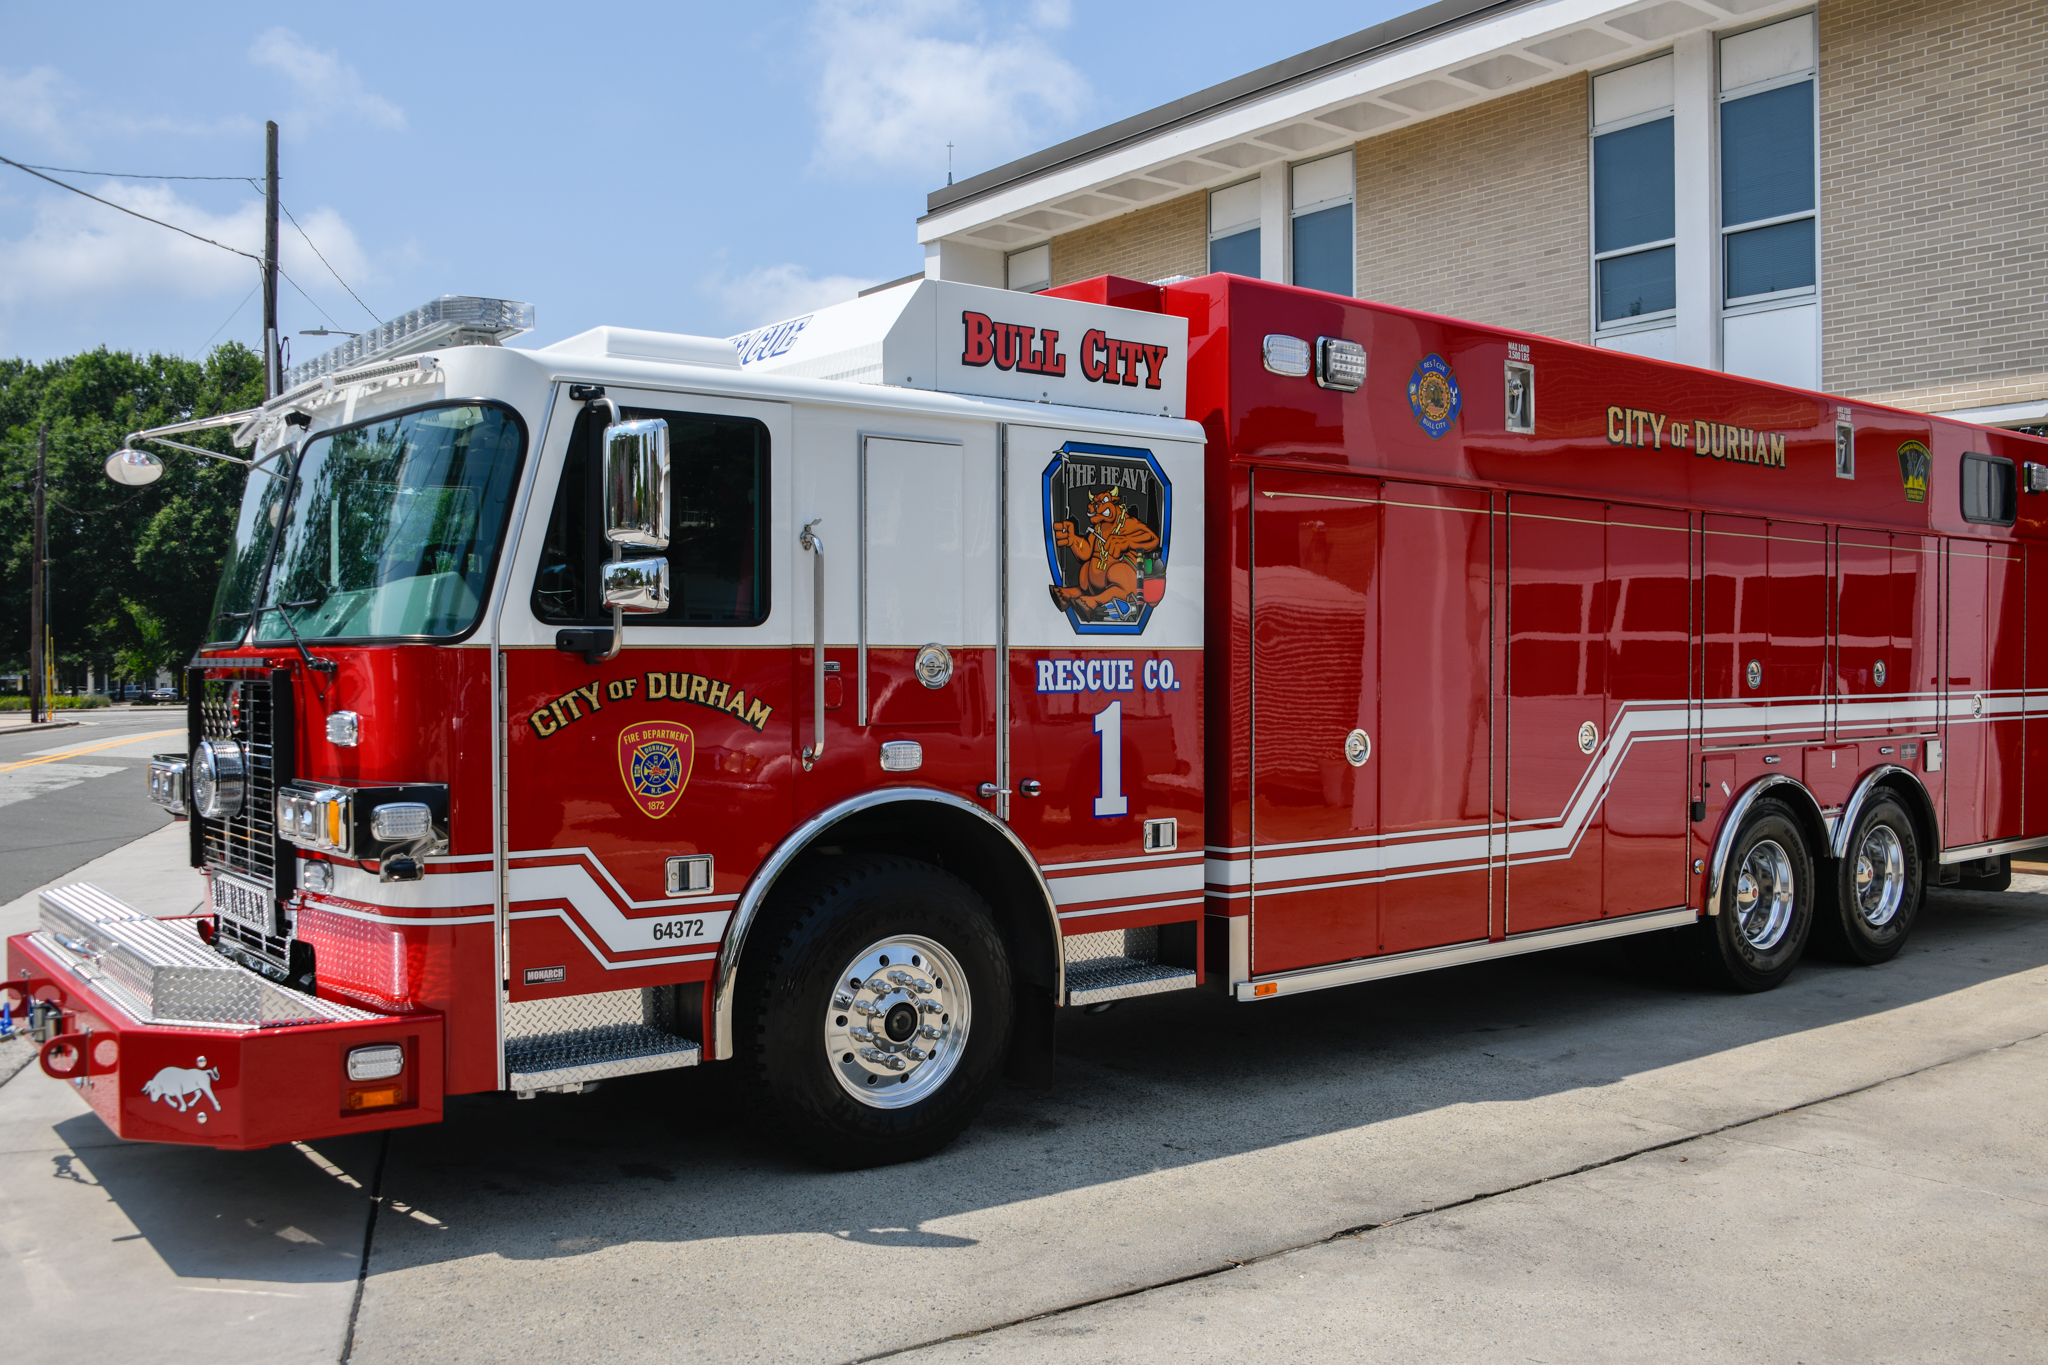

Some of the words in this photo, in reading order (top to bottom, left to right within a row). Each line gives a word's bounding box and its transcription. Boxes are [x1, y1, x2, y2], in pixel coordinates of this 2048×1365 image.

[962, 310, 1066, 378] BULL
[1080, 328, 1168, 390] CITY
[1508, 342, 1518, 351] MAX
[1518, 343, 1530, 353] LOAD
[1508, 350, 1520, 360] 3,500
[1521, 353, 1530, 362] LBS
[1422, 418, 1435, 430] BULL
[1435, 421, 1447, 430] CITY
[1607, 405, 1667, 451] CITY
[1670, 421, 1690, 449] OF
[1694, 419, 1786, 470] DURHAM
[1066, 463, 1097, 489] THE
[1100, 465, 1149, 495] HEAVY
[1035, 658, 1134, 694] RESCUE
[1142, 658, 1181, 693] CO.
[527, 679, 602, 739] CITY
[607, 678, 638, 702] OF
[644, 671, 773, 733] DURHAM
[623, 732, 640, 745] FIRE
[642, 729, 689, 743] DEPARTMENT
[644, 745, 669, 754] DURHAM
[1092, 699, 1129, 819] 1
[647, 800, 665, 810] 1872
[1896, 833, 1917, 934] GOODYEAR
[653, 919, 704, 940] 64372
[527, 968, 563, 981] MONARCH
